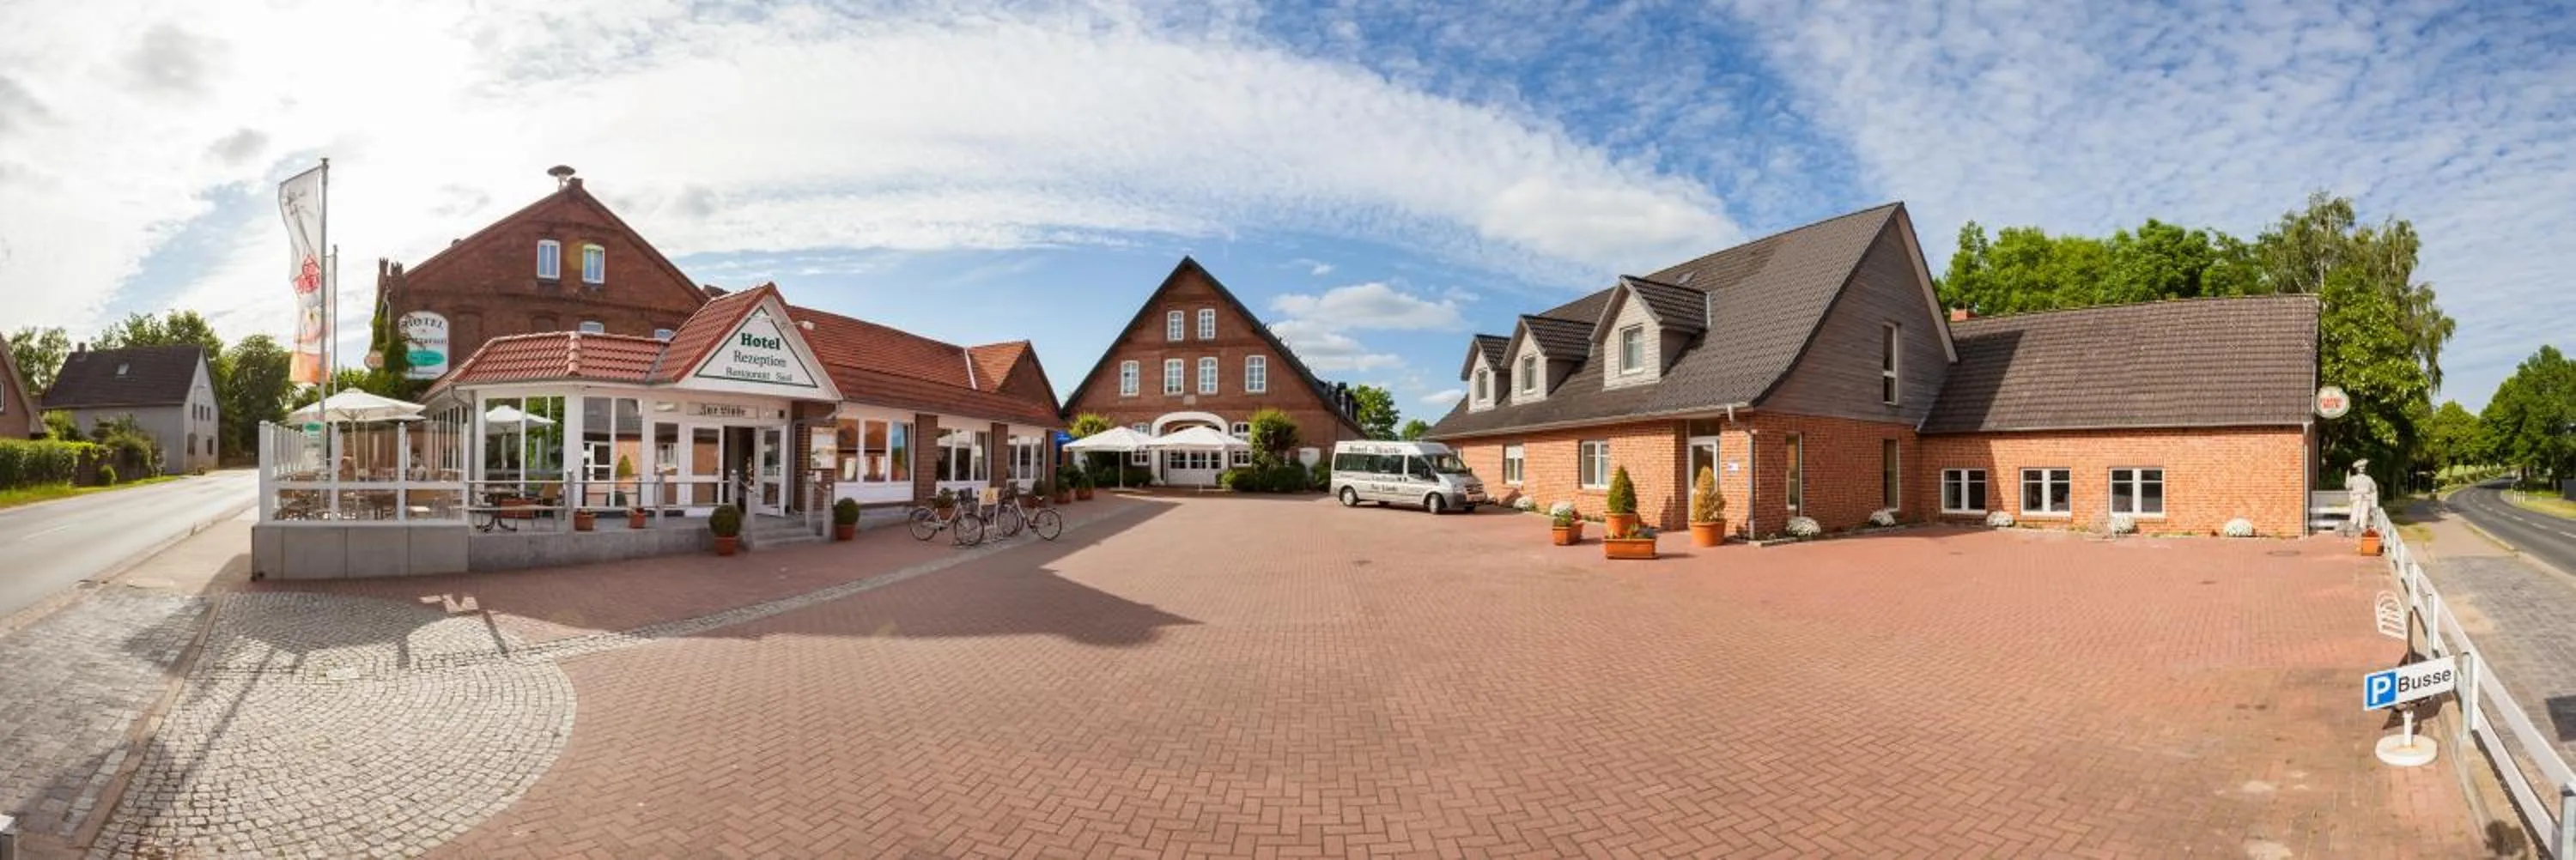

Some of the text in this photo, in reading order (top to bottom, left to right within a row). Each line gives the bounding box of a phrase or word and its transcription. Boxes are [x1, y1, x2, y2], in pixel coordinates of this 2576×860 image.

[740, 332, 781, 350] Hotel
[733, 349, 787, 367] Rezeption
[2372, 669, 2451, 704] P Busse
